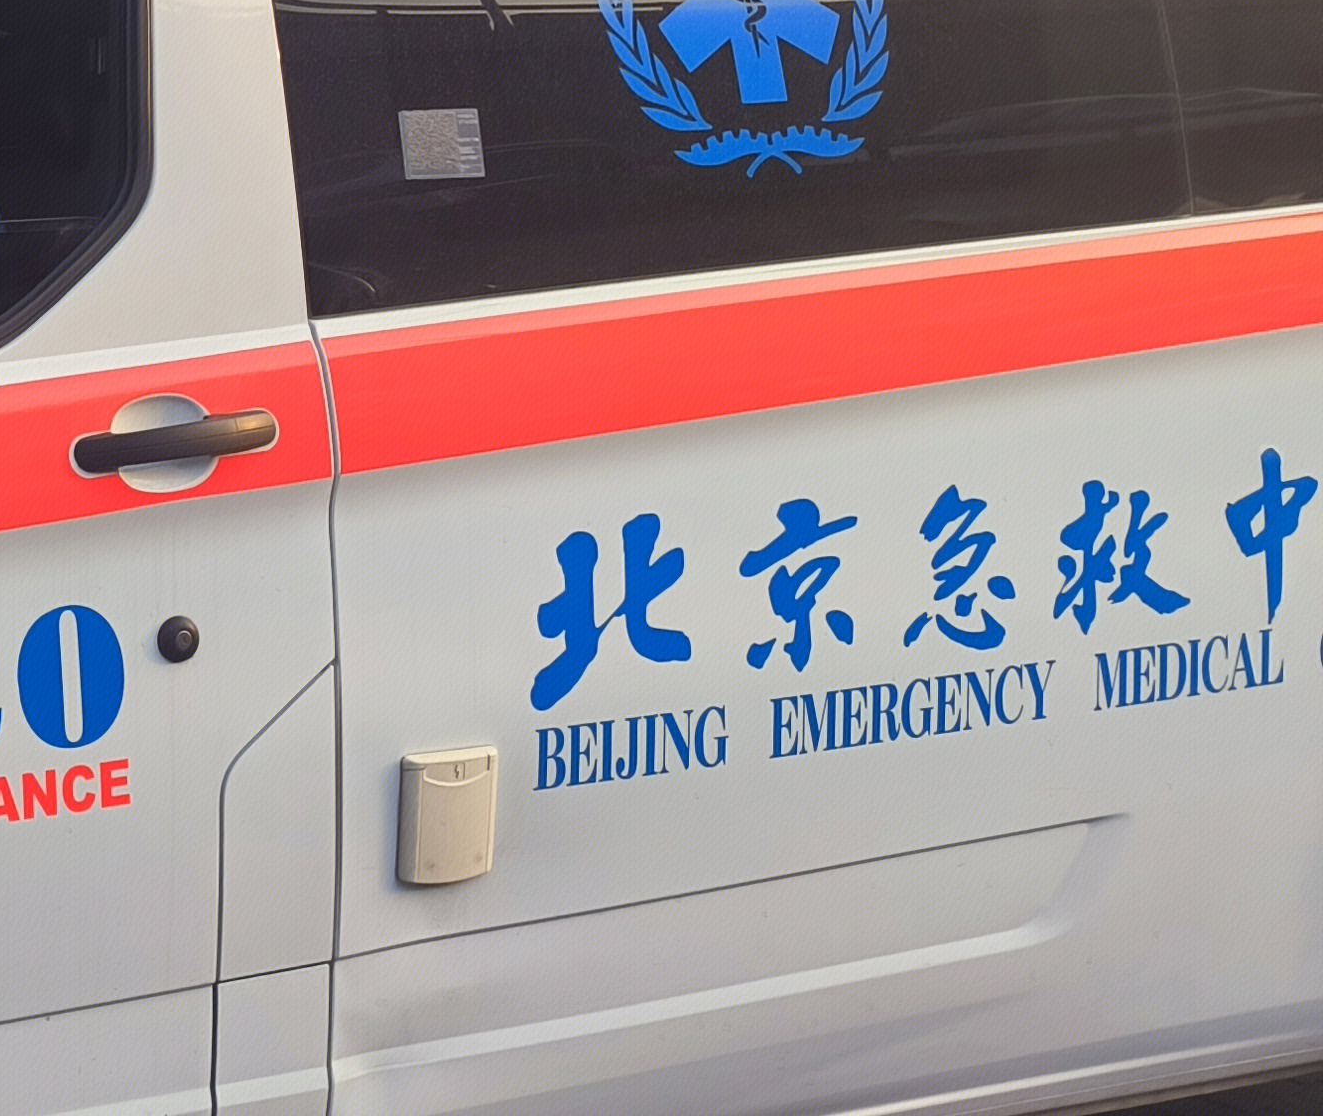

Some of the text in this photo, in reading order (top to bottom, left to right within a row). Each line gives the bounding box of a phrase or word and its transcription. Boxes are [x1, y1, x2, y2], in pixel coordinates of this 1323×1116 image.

[529, 447, 1320, 712] 北京急救中
[533, 705, 729, 792] BEIJING
[768, 660, 1056, 760] EMERGENCY
[1093, 627, 1285, 713] MEDICAL
